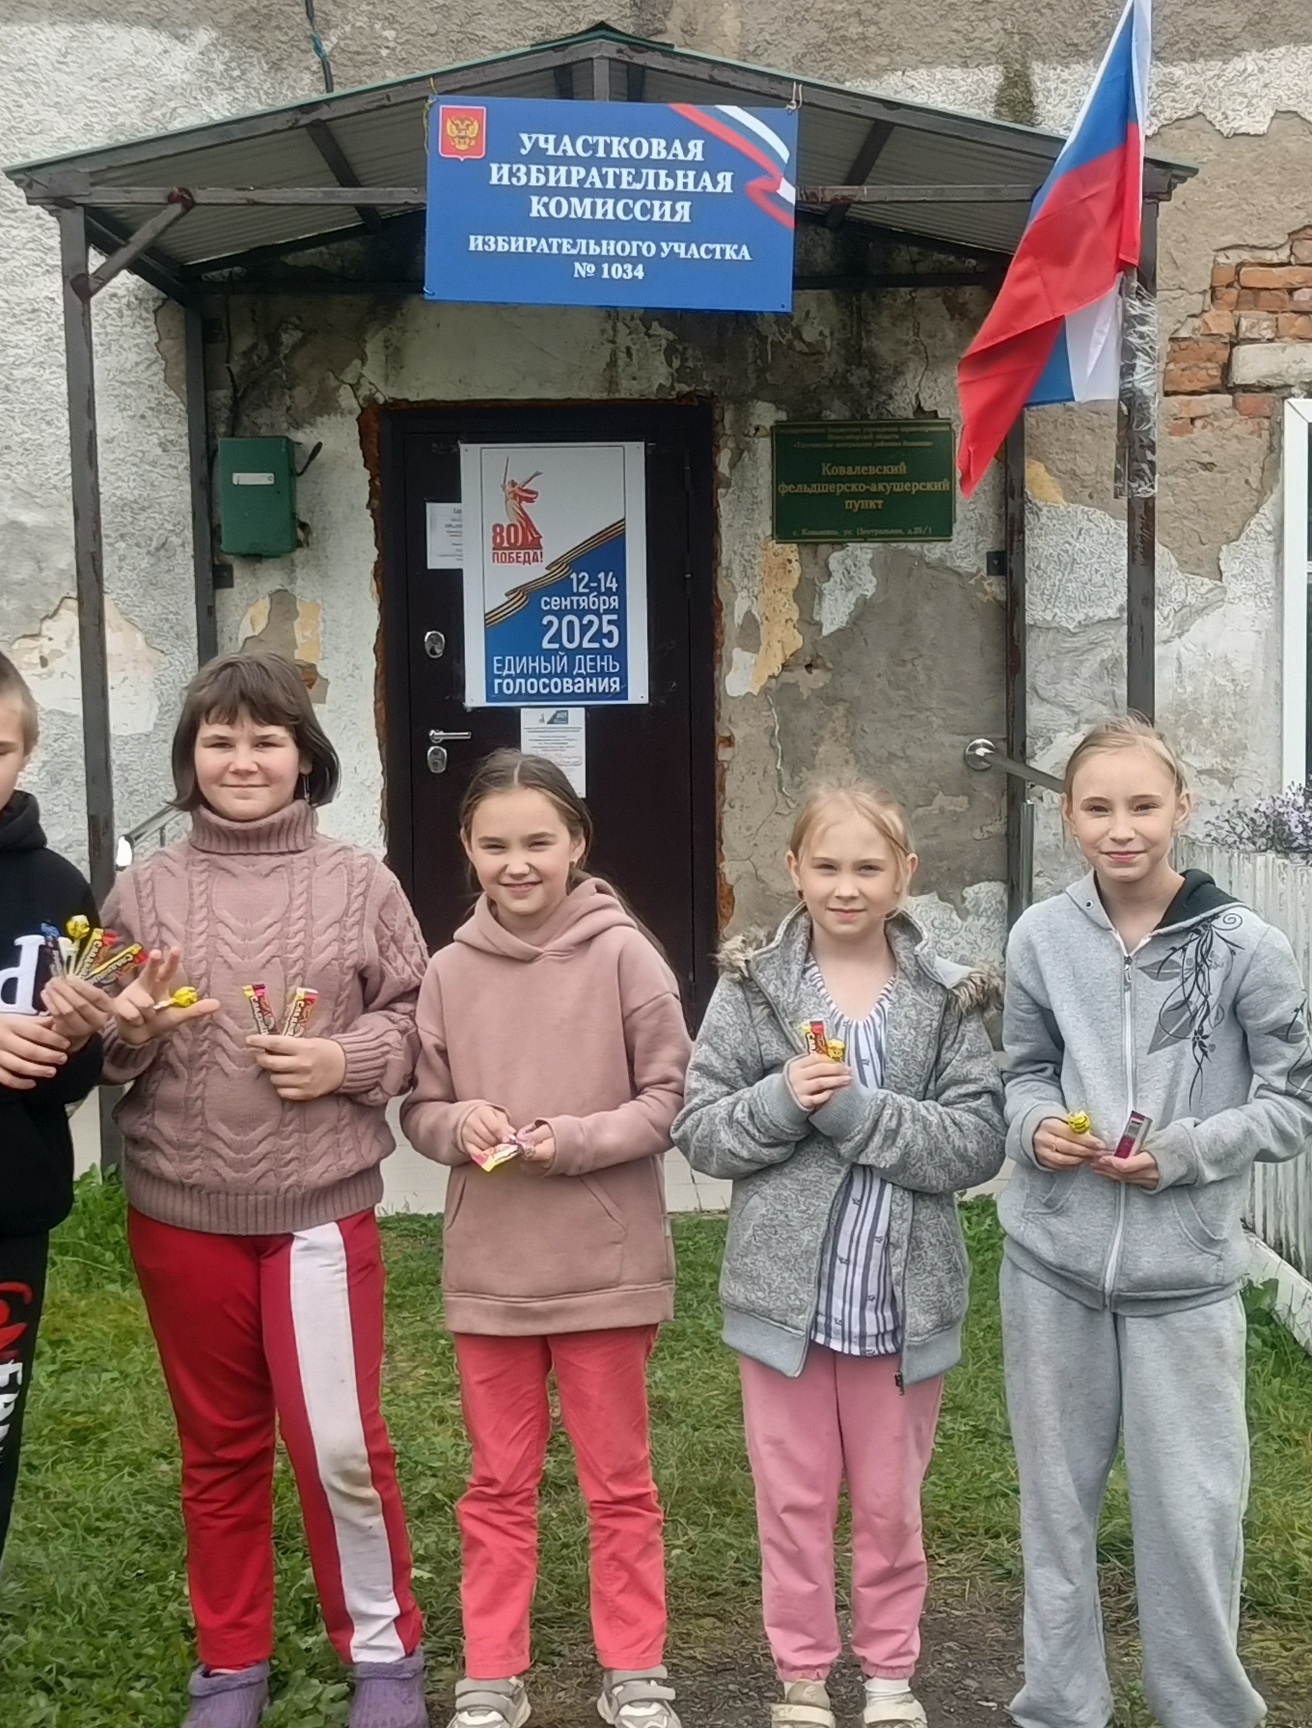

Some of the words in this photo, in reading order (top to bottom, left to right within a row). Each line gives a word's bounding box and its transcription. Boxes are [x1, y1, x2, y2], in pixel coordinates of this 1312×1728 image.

[519, 132, 706, 162] УЧАСТКОВАЯ
[488, 163, 734, 194] ИЗБИРАТЕЛЬНАЯ
[528, 195, 692, 223] КОМИССИЯ
[468, 235, 656, 257] ИЗБИРАТЕЛЬНОГО
[660, 241, 753, 261] УЧАСТКА
[573, 262, 595, 278] №
[601, 263, 645, 280] 1034
[821, 461, 907, 476] Ковалевский
[777, 478, 951, 497] фельдшерско-акушерский
[844, 499, 884, 512] пункт
[492, 523, 522, 547] 80
[492, 551, 543, 565] ПОБЕДА!
[569, 571, 618, 593] 12-14
[540, 592, 620, 613] сентября
[541, 614, 620, 649] 2025
[493, 651, 569, 677] ЕДИНЫЙ
[573, 654, 620, 675] ДЕНЬ
[494, 676, 621, 695] голосования
